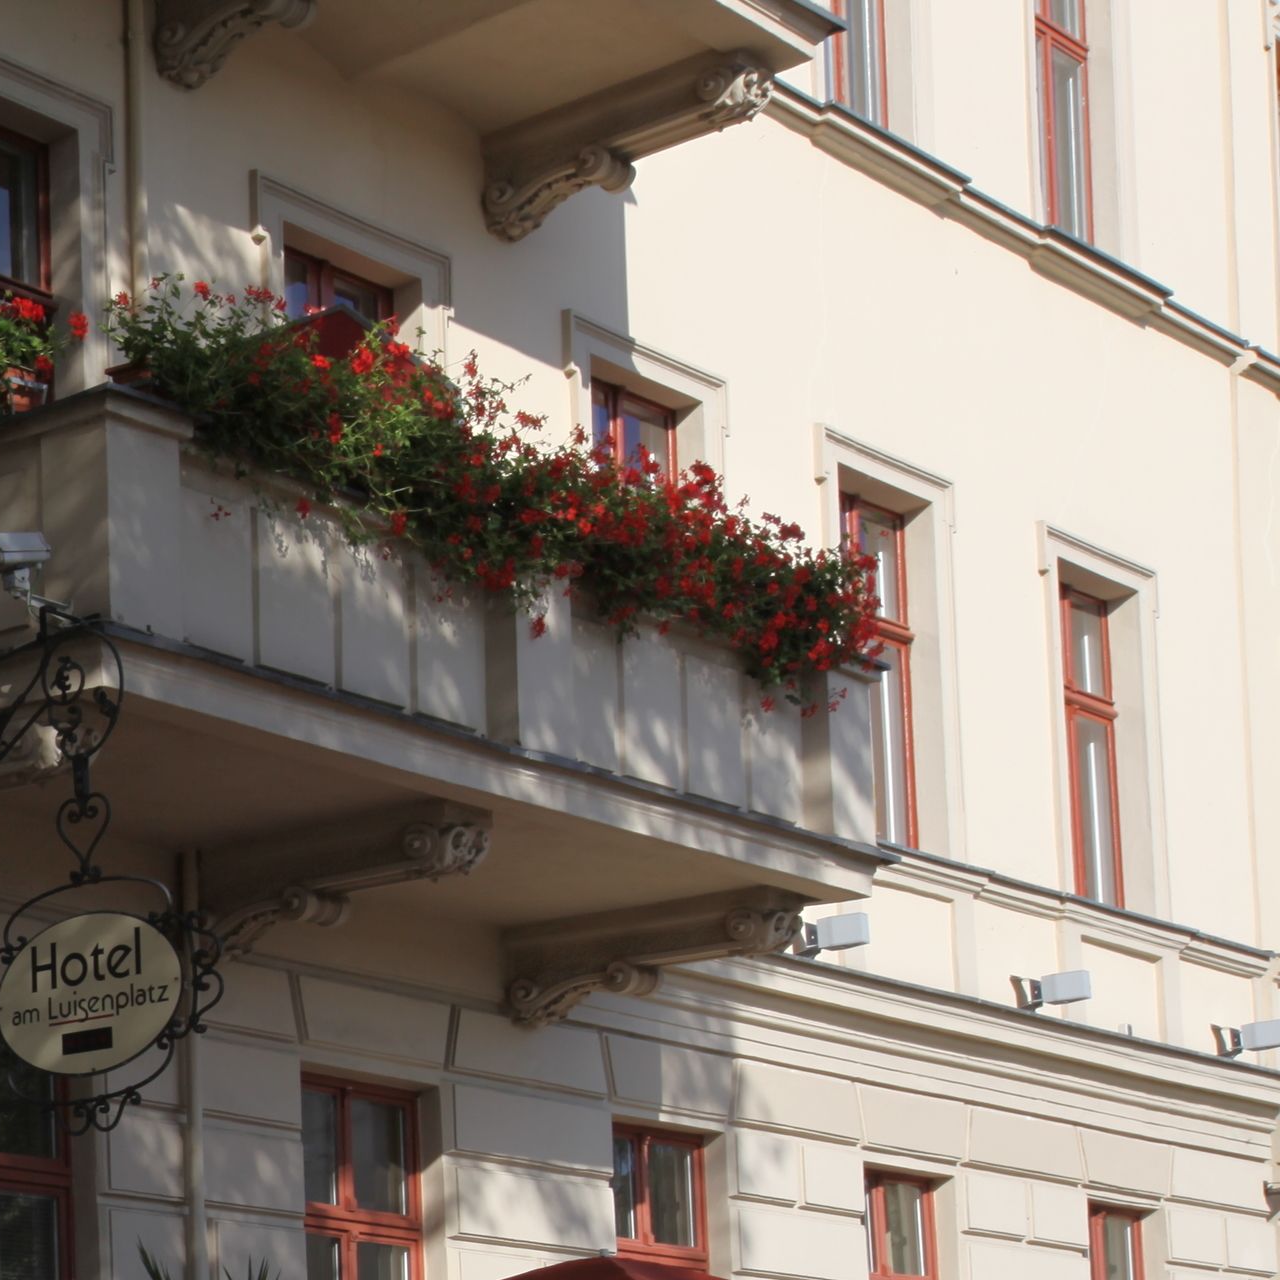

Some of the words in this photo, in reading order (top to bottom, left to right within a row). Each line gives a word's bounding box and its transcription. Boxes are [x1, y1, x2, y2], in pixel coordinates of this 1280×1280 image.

[31, 926, 142, 993] Hotel
[11, 1006, 40, 1026] am
[47, 982, 169, 1023] Luisenplatz
